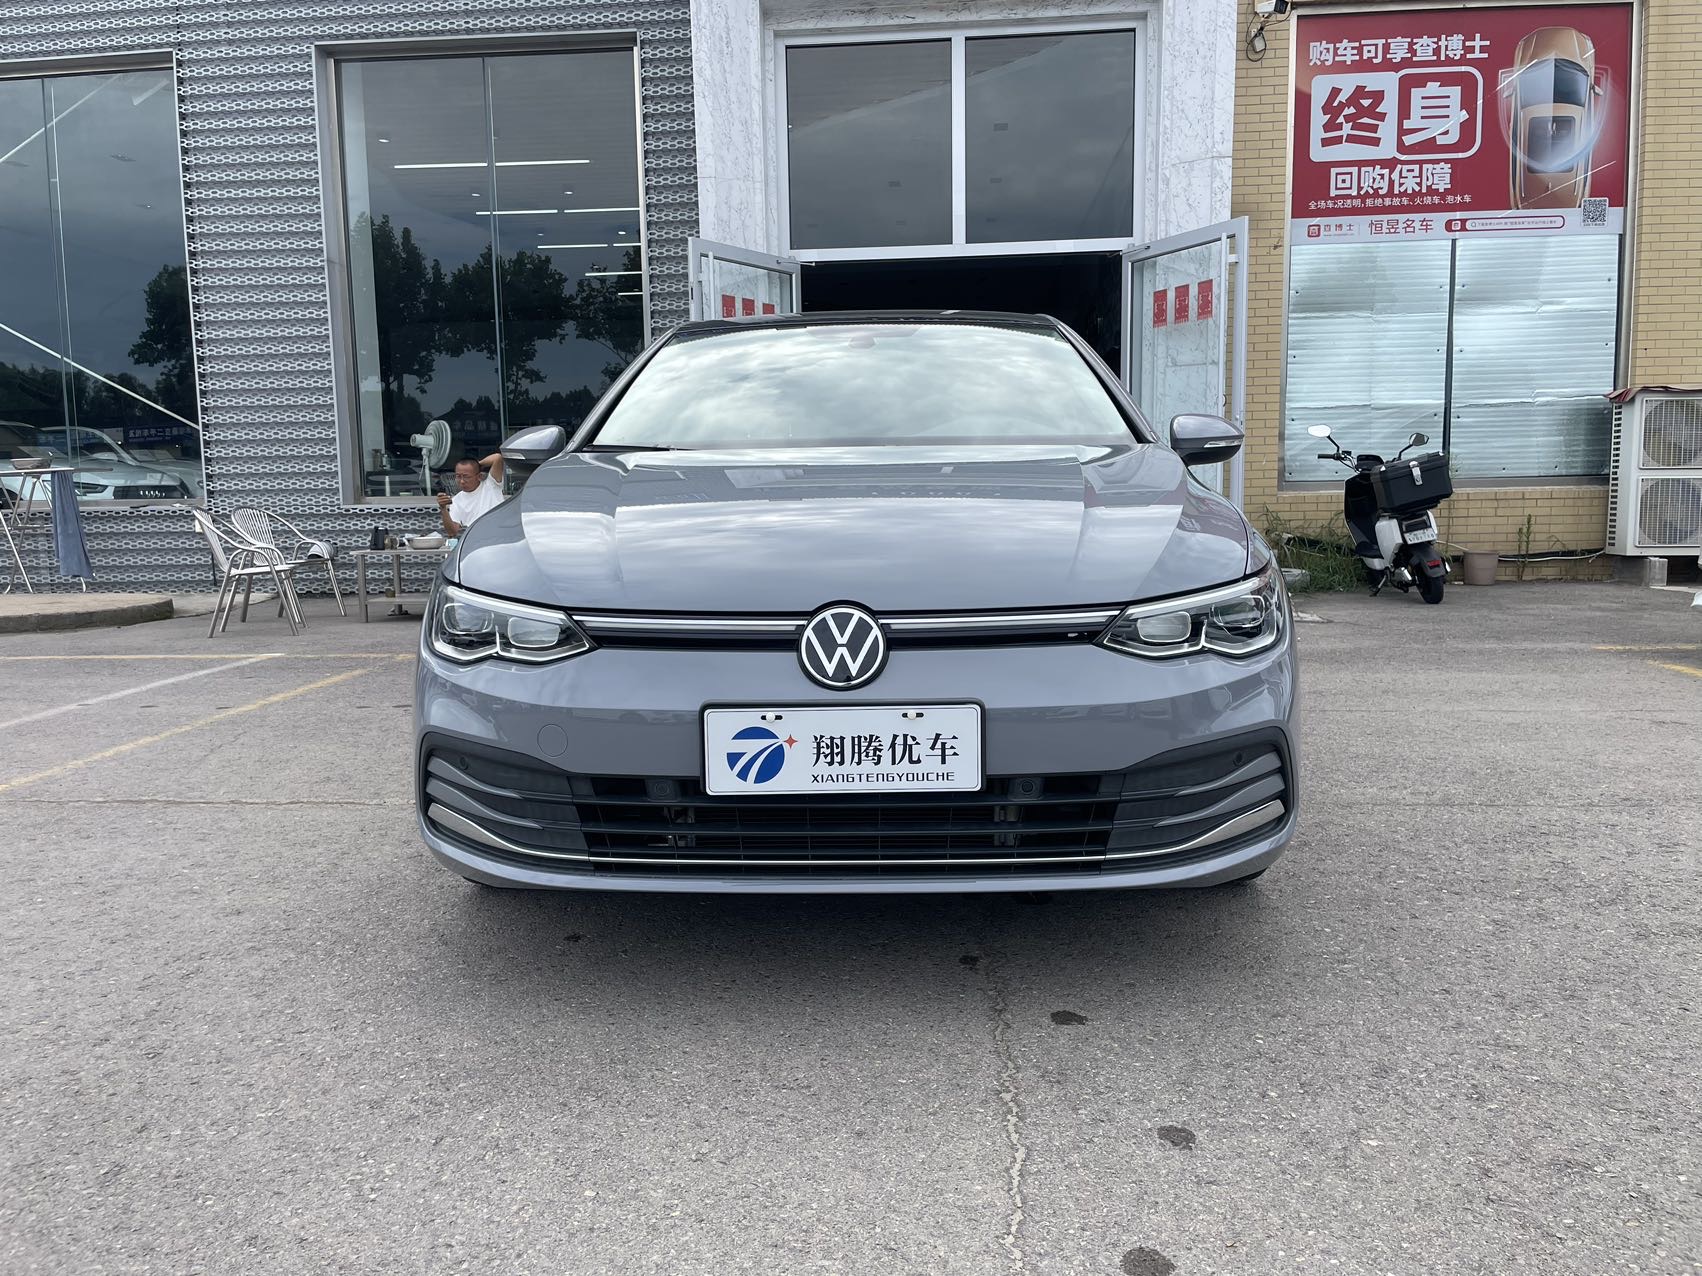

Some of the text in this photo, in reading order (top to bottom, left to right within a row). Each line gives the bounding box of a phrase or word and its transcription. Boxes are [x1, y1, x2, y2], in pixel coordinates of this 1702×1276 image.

[1309, 33, 1490, 66] 购车可享查博士
[1320, 81, 1470, 148] 终身
[1329, 162, 1452, 197] 回购保障
[1368, 218, 1434, 236] 恒昱名车
[811, 732, 960, 768] 翔腾优车
[811, 771, 955, 784] XIANGTENGYOUCHE
